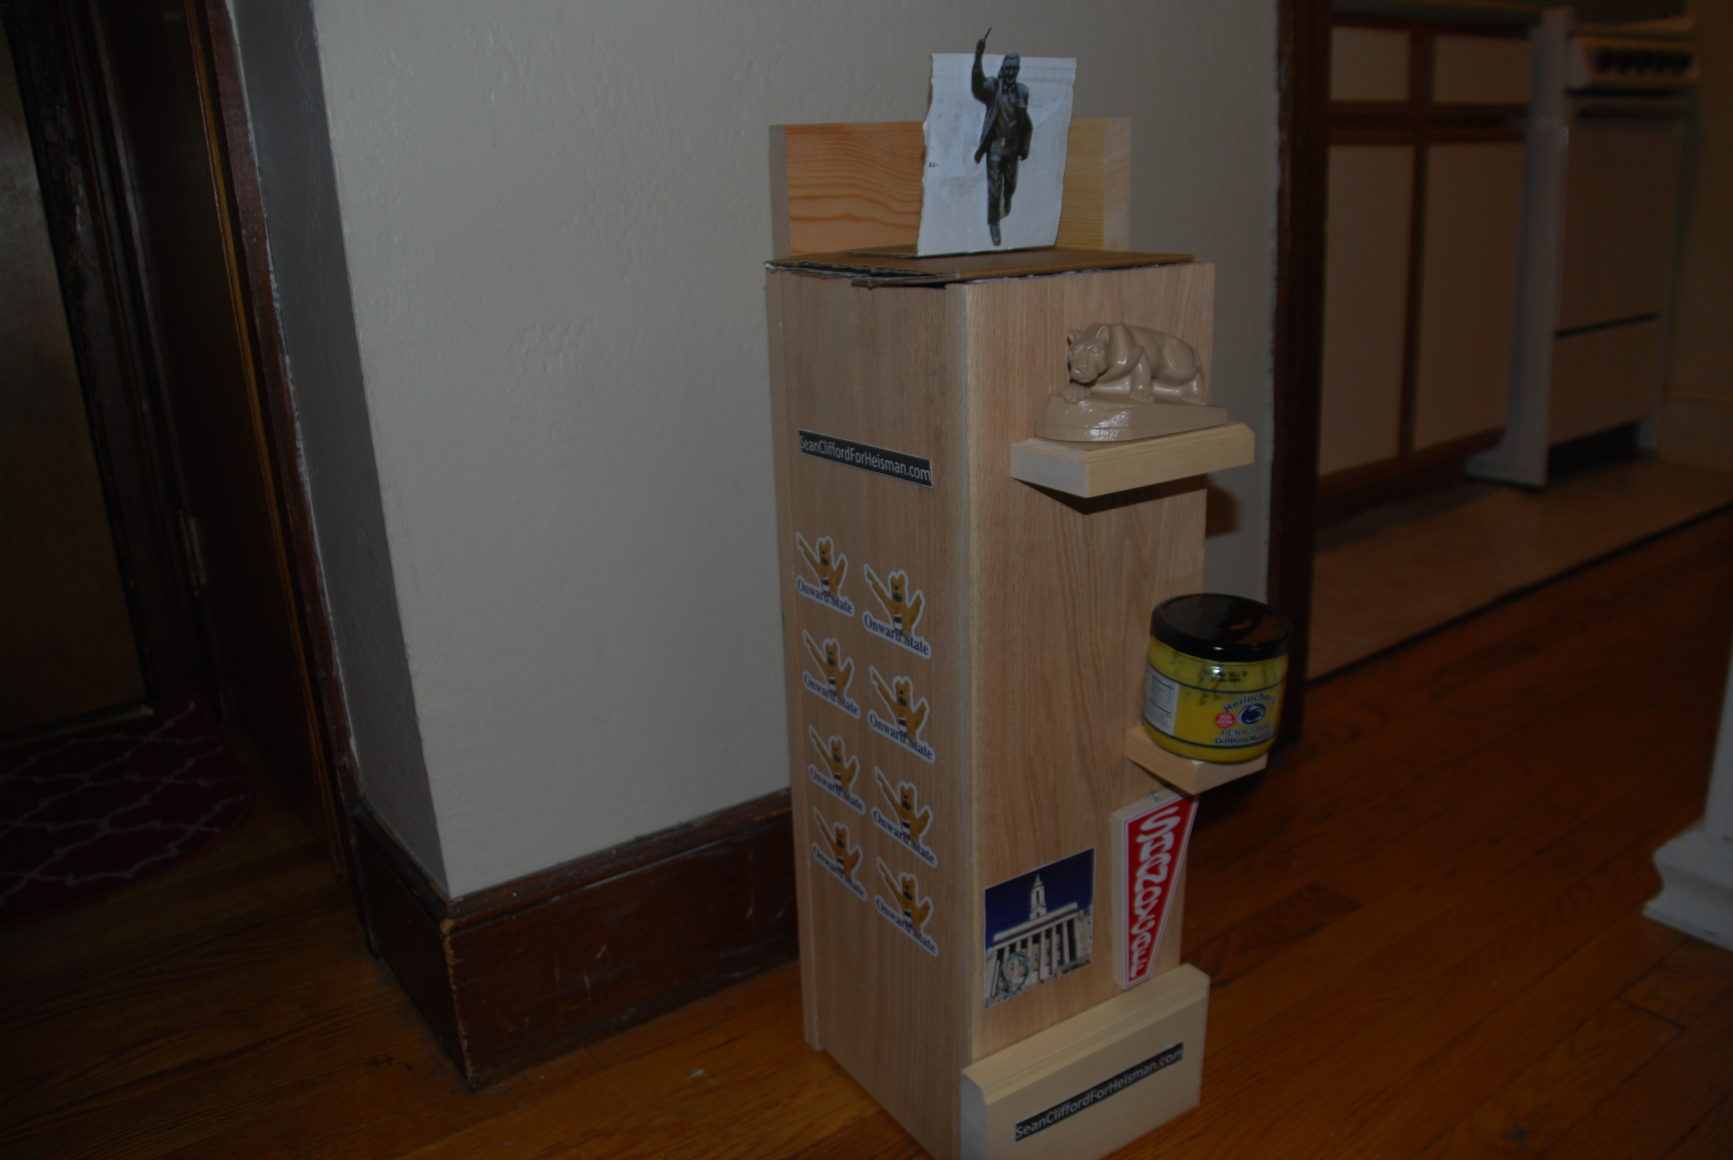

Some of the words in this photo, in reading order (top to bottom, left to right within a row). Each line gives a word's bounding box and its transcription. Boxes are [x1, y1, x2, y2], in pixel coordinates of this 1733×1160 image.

[800, 435, 932, 481] SeanCliffordForHeisman.com
[864, 614, 905, 642] Onward
[1016, 1050, 1183, 1139] SeanCliffordForHeisman.com
